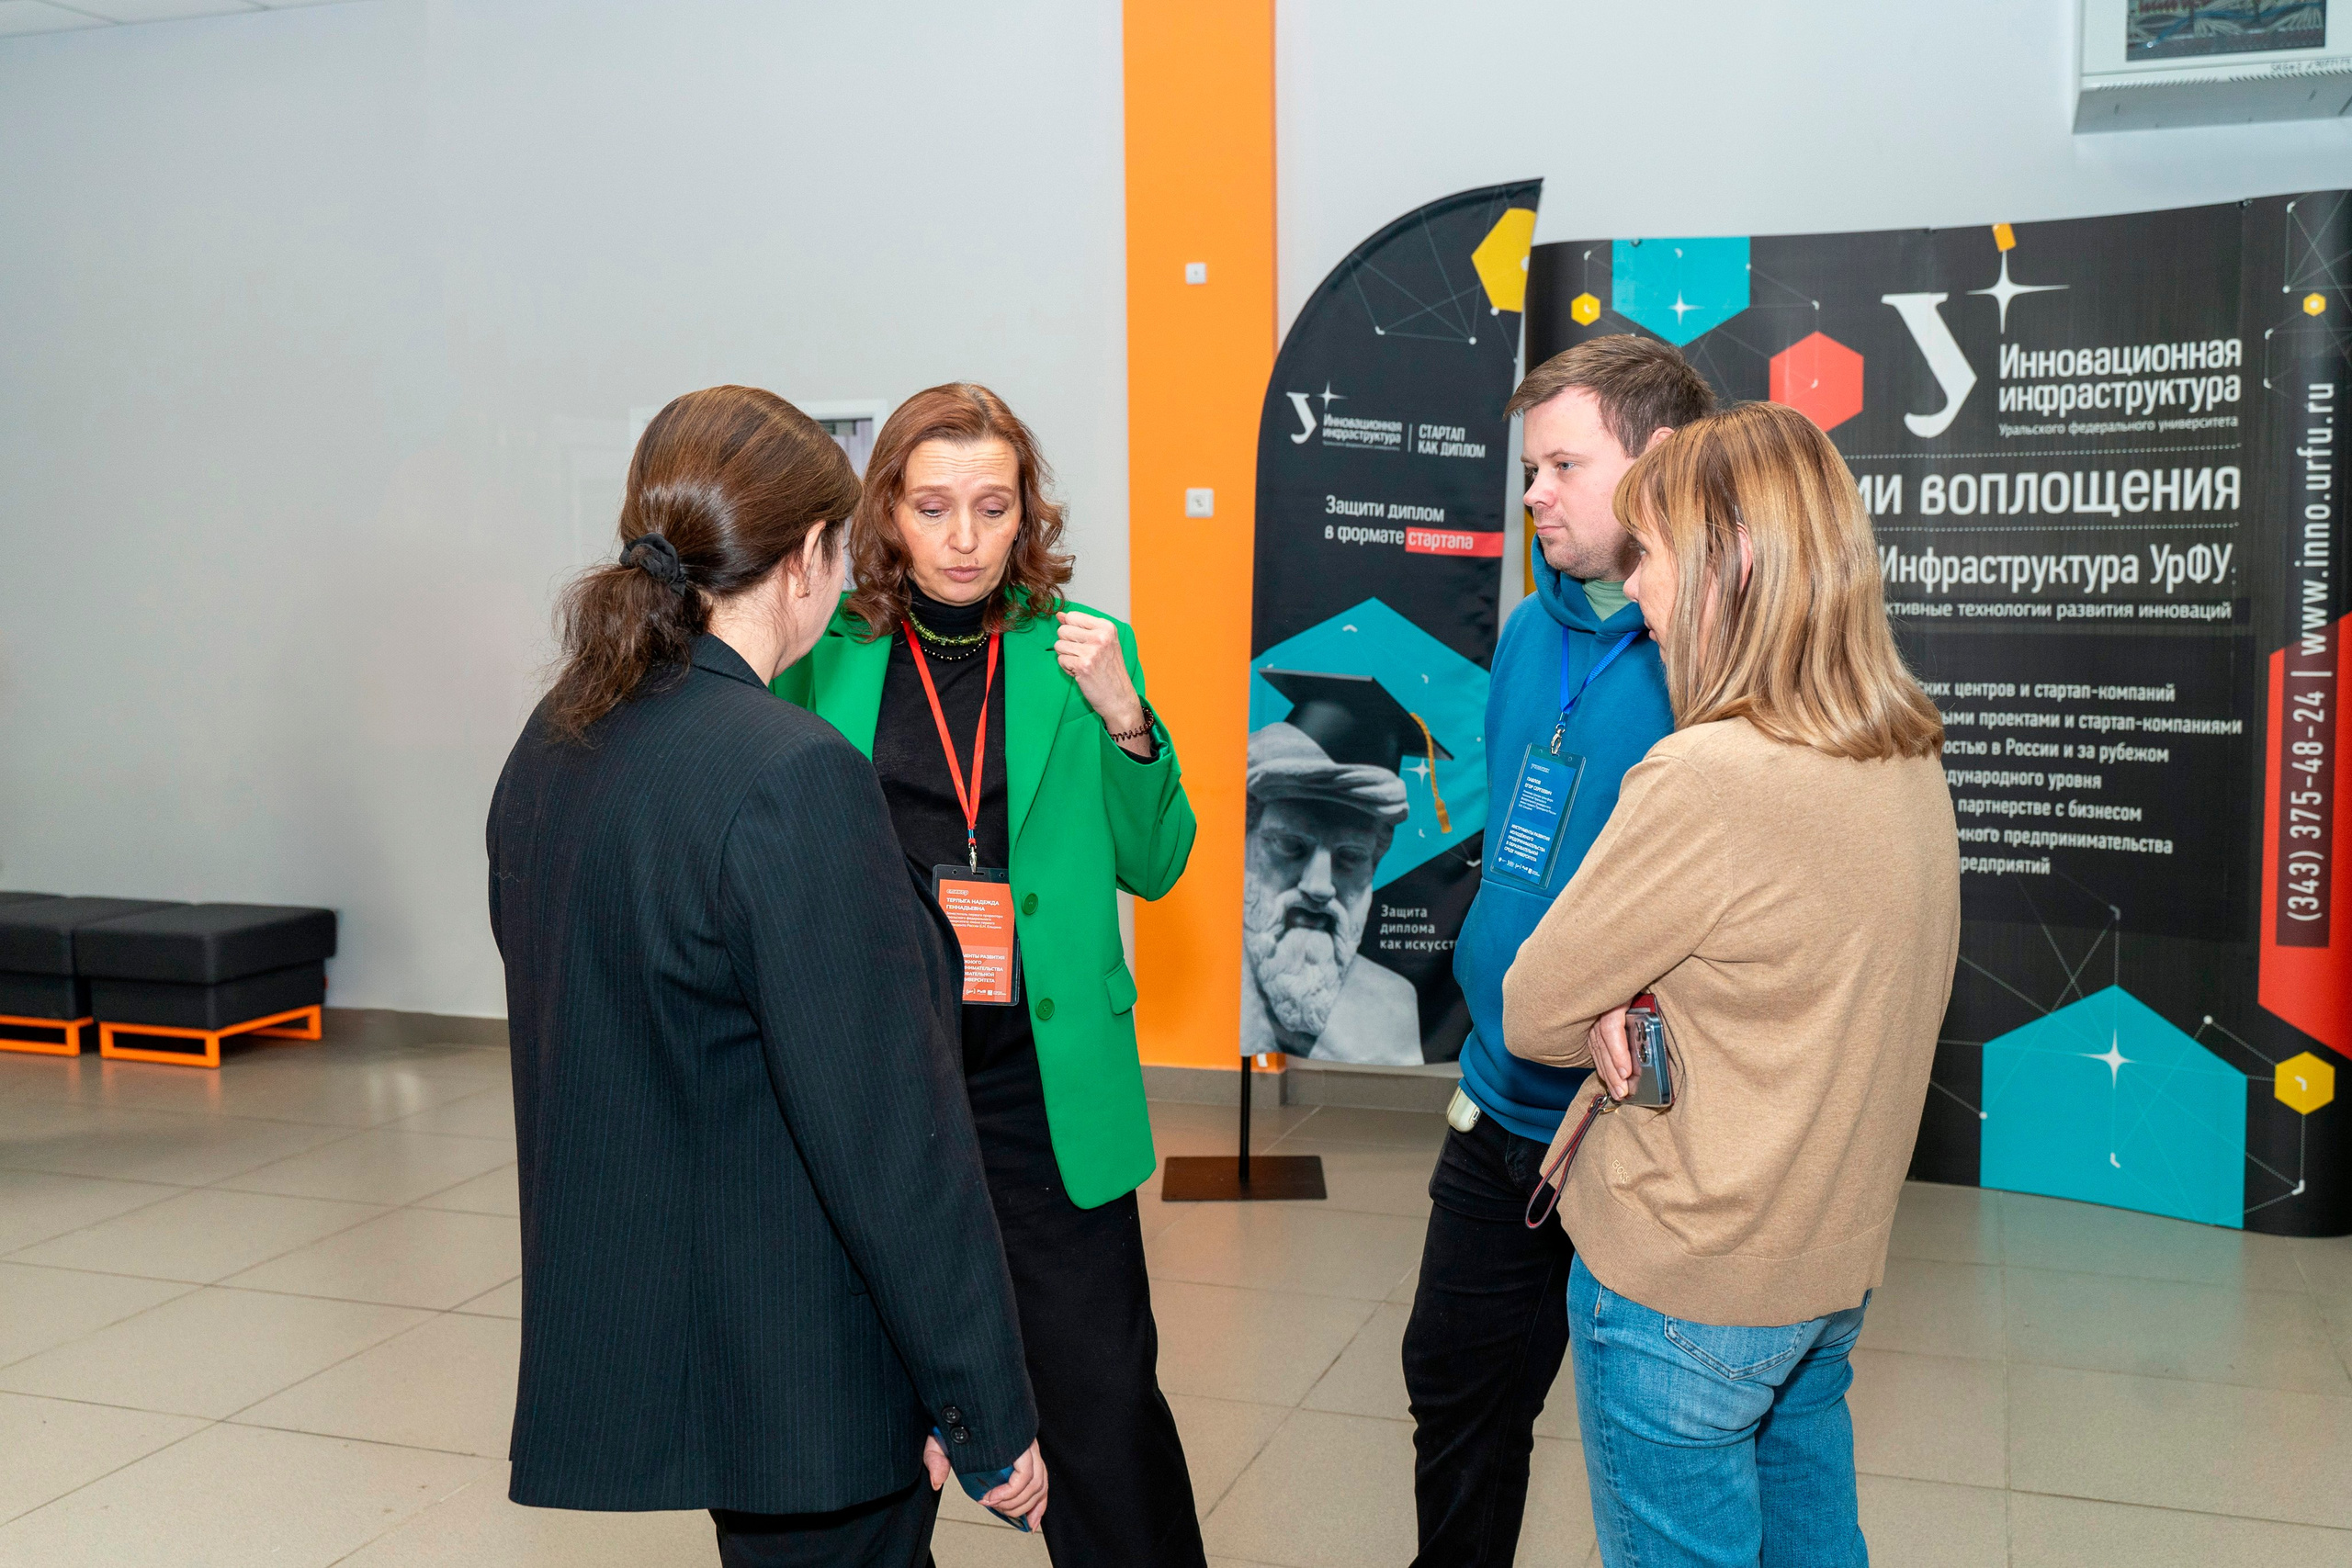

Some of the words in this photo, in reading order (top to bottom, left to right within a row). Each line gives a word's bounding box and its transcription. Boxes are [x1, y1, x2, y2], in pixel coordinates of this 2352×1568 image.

[1999, 338, 2243, 380] Инновационная
[1998, 375, 2242, 418] инфраструктура
[1323, 413, 1403, 433] Инновационная
[1418, 423, 1465, 442] СТАРТАП
[1998, 423, 2066, 438] Уральского
[2068, 419, 2156, 436] федерального
[2158, 415, 2239, 434] университета
[1322, 427, 1402, 446] инфраструктура
[1418, 440, 1438, 455] КАК
[1440, 443, 1486, 458] ДИПЛОМ
[1920, 466, 2242, 517] воплощения
[1325, 494, 1385, 518] Защити
[1387, 504, 1445, 523] диплом
[2294, 383, 2335, 657] www.inno.urfu.ru
[1324, 525, 1334, 540] в
[1337, 525, 1405, 547] формате
[1408, 530, 1474, 551] стартапа
[1879, 544, 2140, 594] Инфраструктура
[1958, 603, 2052, 617] технологии
[2056, 604, 2134, 621] развития
[2138, 601, 2232, 622] инноваций
[1954, 682, 2016, 701] центров
[2020, 683, 2030, 697] и
[2034, 682, 2176, 703] стартап-компаний
[1979, 712, 2060, 730] проектами
[2064, 715, 2075, 728] и
[2078, 714, 2244, 735] стартап-компаниями
[1991, 740, 2002, 755] в
[2006, 738, 2060, 758] России
[2064, 743, 2074, 758] и
[2077, 743, 2096, 760] за
[2099, 741, 2169, 764] рубежом
[2290, 691, 2325, 840] 375-48-24
[1945, 769, 2044, 788] дународного
[2048, 773, 2102, 792] уровня
[1958, 798, 2052, 818] партнерстве
[2055, 802, 2065, 817] с
[2068, 798, 2143, 822] бизнесом
[2004, 829, 2174, 854] предпринимательства
[2287, 851, 2324, 921] (343)
[1381, 904, 1429, 919] Защита
[1380, 923, 1436, 935] диплома
[1379, 939, 1402, 951] как
[1612, 1159, 1630, 1184] BOSS
